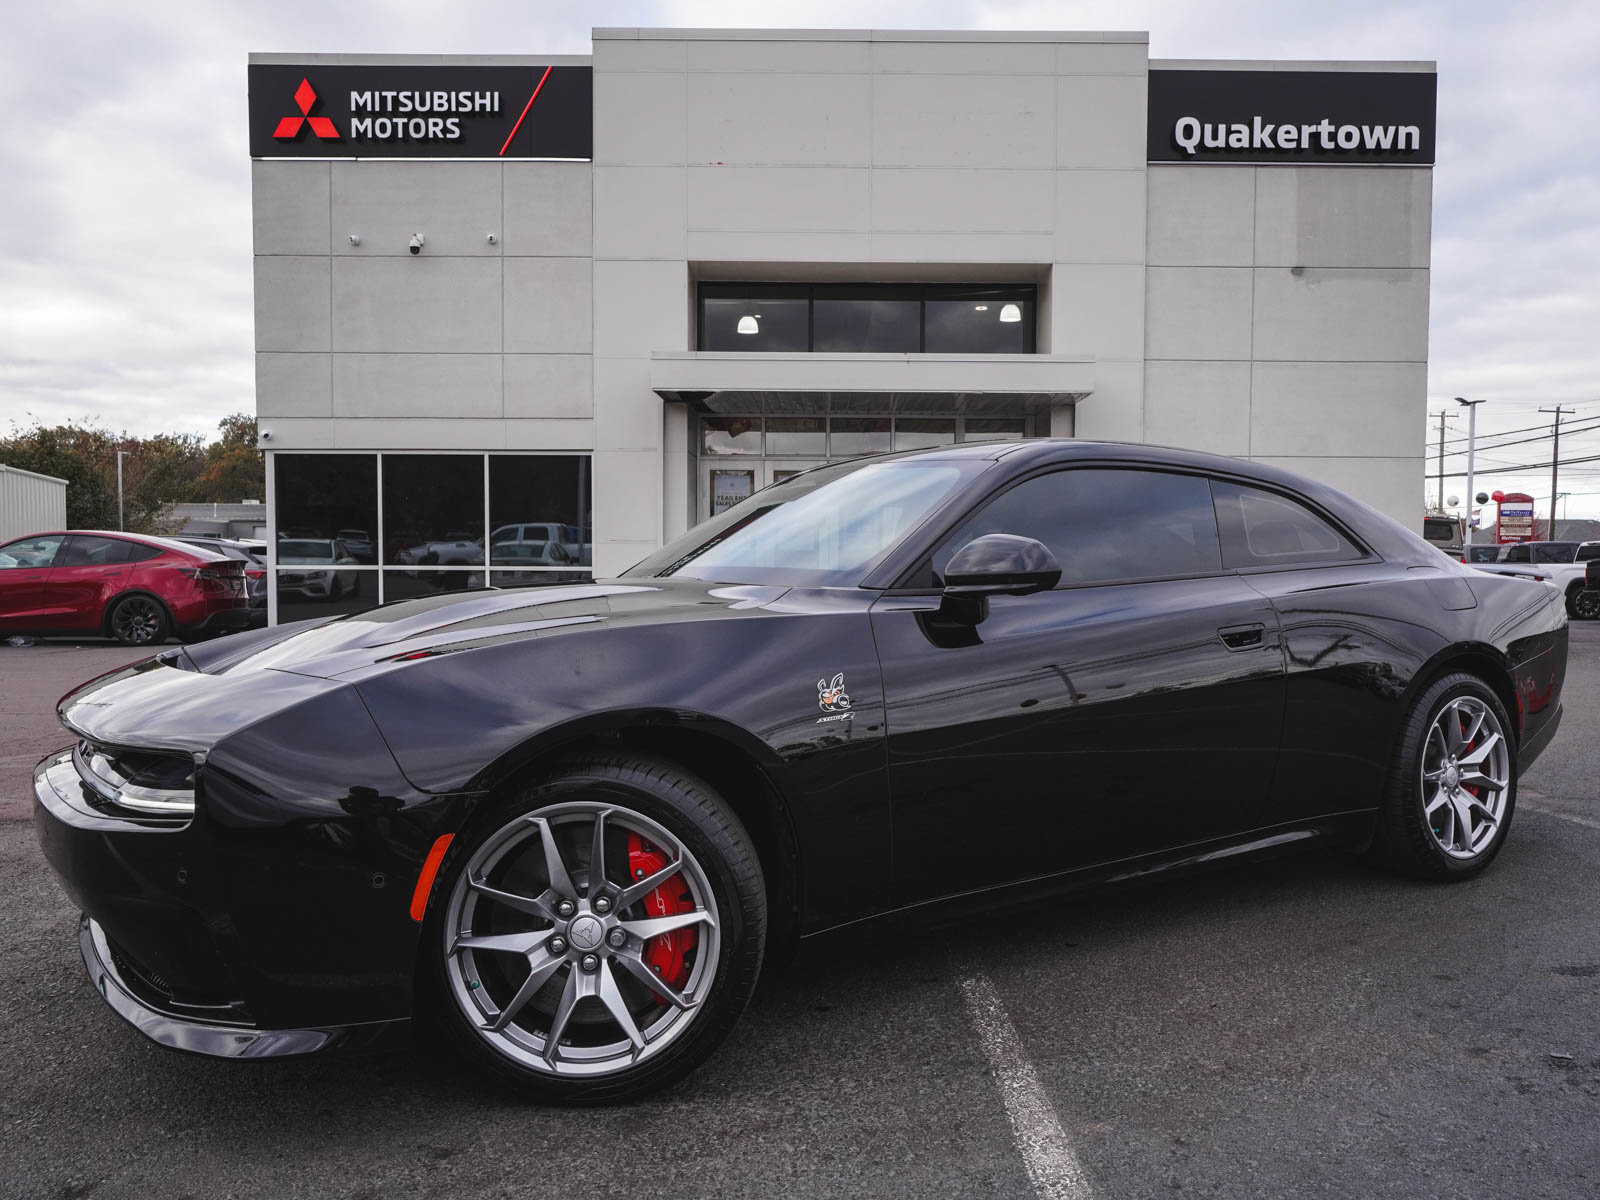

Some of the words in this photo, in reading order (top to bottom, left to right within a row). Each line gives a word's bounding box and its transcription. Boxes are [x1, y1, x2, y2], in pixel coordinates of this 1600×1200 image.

[350, 91, 499, 112] MITSUBISHI
[350, 118, 460, 139] MOTORS
[1174, 116, 1420, 154] Quakertown
